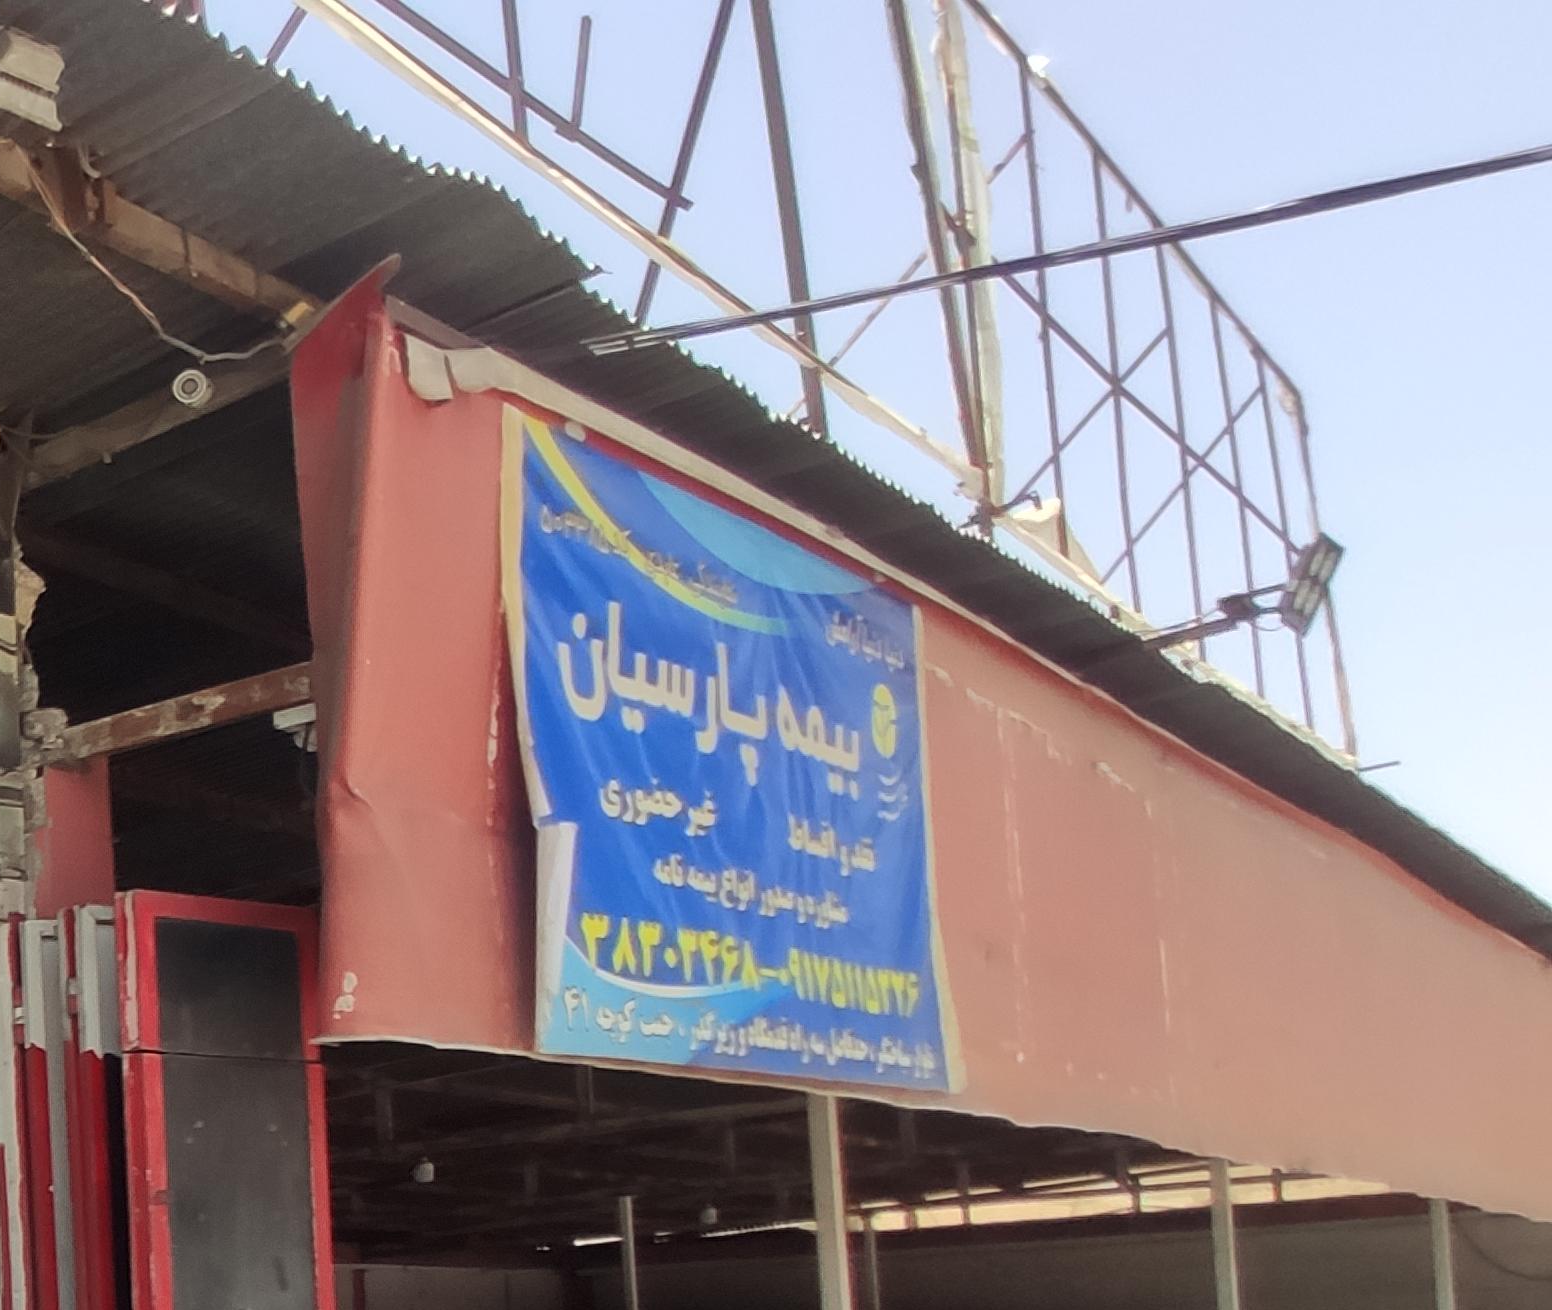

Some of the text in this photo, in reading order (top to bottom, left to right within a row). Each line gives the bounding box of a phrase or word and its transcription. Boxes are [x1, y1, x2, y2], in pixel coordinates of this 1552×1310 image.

[556, 600, 861, 800] بیمه پارسیان
[599, 777, 683, 826] حضوری
[684, 789, 717, 837] غیر
[652, 852, 685, 889] نامه
[686, 865, 717, 903] بیمه
[718, 868, 756, 912] انواع
[563, 987, 590, 1033] ۴۱
[596, 997, 637, 1044] کوچه
